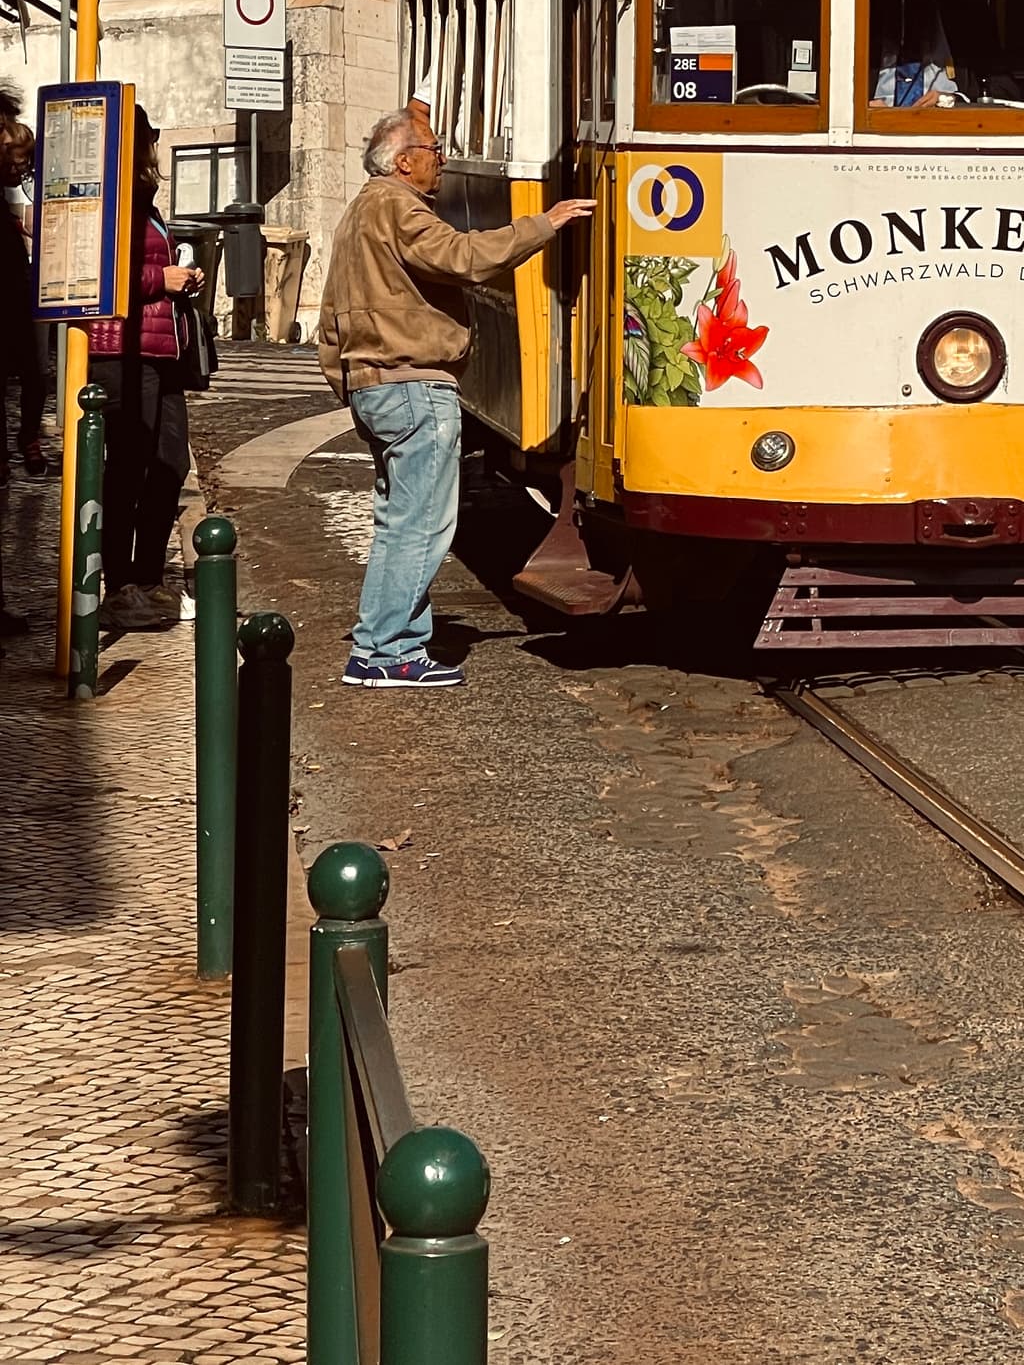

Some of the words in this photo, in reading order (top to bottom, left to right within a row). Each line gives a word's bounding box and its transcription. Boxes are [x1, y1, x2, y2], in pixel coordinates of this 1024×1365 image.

[673, 58, 697, 70] 28E
[673, 81, 697, 99] 08
[868, 163, 950, 172] RESPONSÁVEL
[809, 262, 1004, 304] SCHWARZWALD
